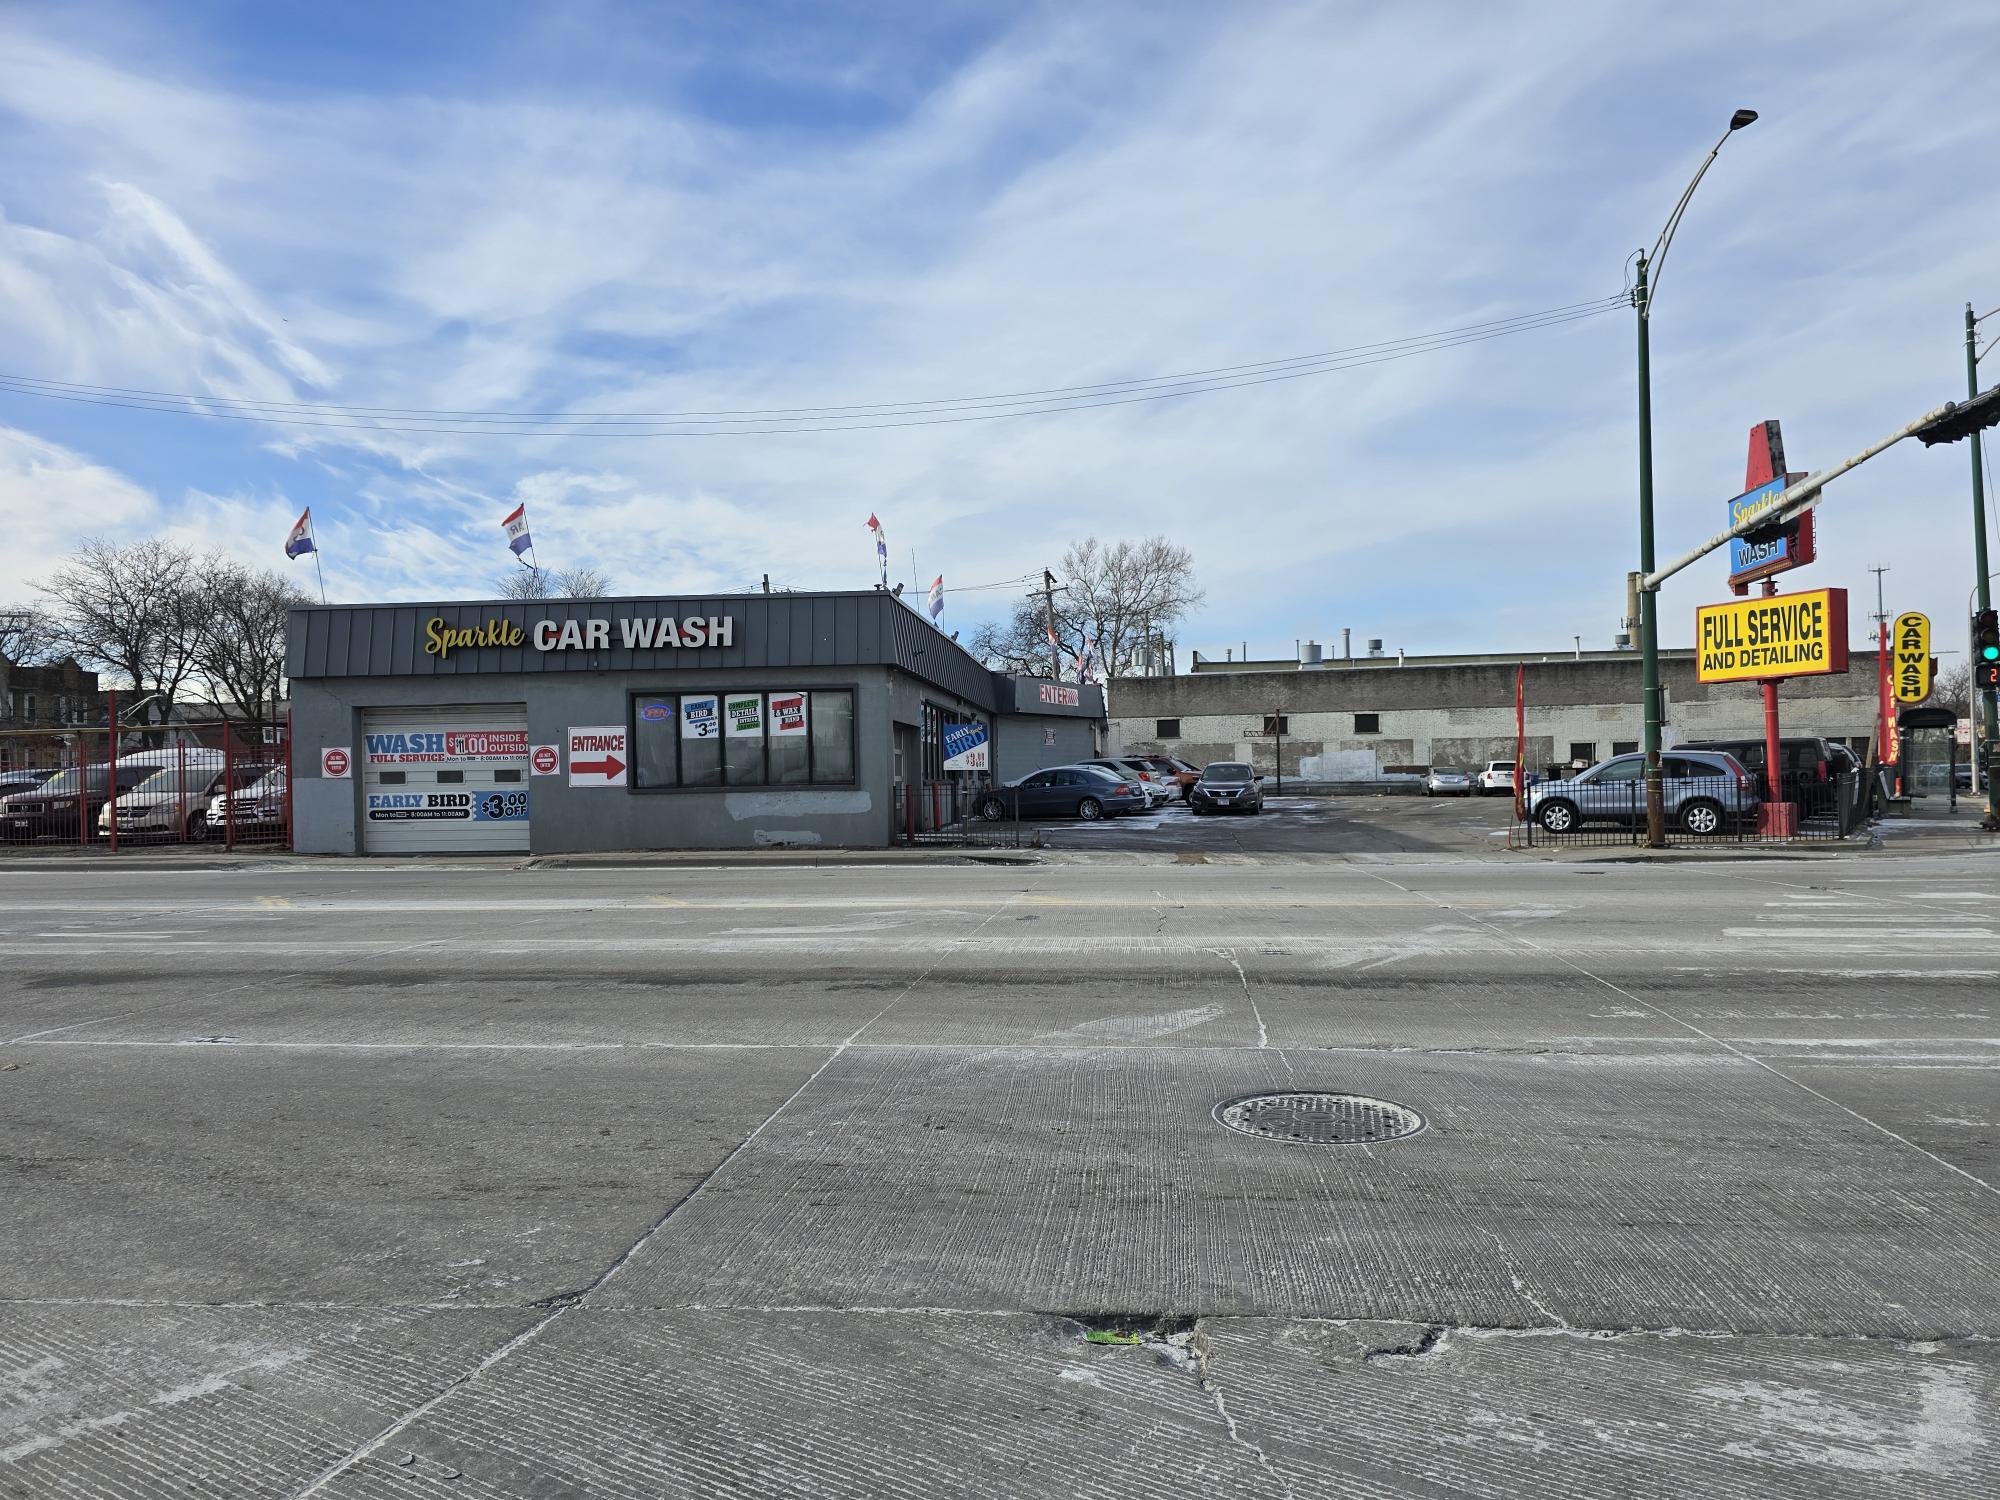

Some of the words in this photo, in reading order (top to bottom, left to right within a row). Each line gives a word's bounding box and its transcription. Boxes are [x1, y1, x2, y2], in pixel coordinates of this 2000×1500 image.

[1737, 541, 1779, 567] WASH
[1703, 613, 1743, 650] FULL
[1747, 602, 1822, 646] SERVICE
[1901, 616, 1922, 650] CAR
[425, 617, 526, 659] Sparkle
[533, 619, 610, 651] CAR
[619, 616, 734, 649] WASH
[1703, 651, 1735, 670] AND
[1740, 642, 1822, 668] DETAILING
[1898, 653, 1925, 697] WASH
[1990, 668, 1998, 682] 2
[1040, 685, 1067, 704] ENTER
[690, 709, 708, 718] BIRD
[731, 708, 756, 717] DETAIL
[366, 734, 445, 753] WASH
[489, 734, 521, 742] INSIDE
[571, 735, 625, 752] ENTRANCE
[945, 726, 969, 743] EARLY
[946, 731, 985, 757] BIRD
[370, 754, 397, 763] FULL
[398, 754, 445, 762] SERVICE
[368, 795, 423, 808] EARLY
[427, 794, 470, 807] BIRD
[481, 792, 527, 819] $3.00
[504, 806, 527, 817] OFF
